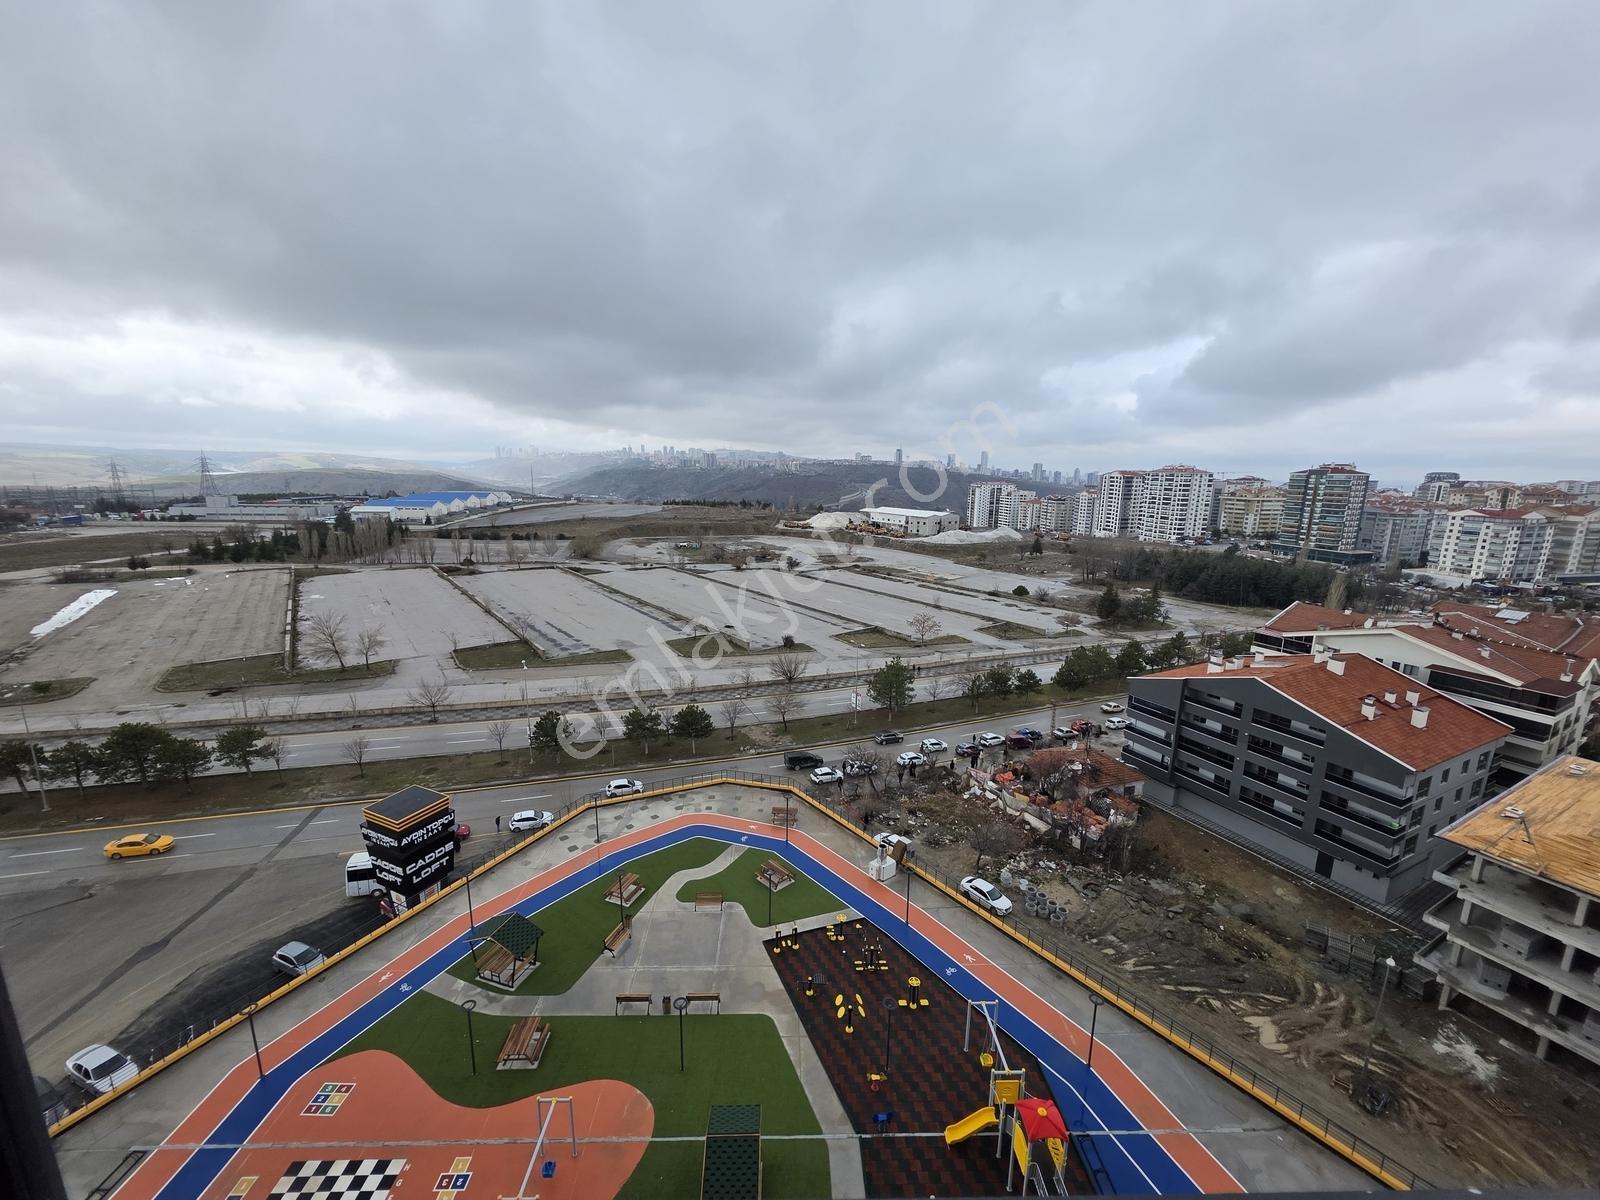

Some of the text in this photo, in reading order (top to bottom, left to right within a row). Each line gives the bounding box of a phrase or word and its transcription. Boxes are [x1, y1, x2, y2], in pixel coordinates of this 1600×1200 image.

[369, 856, 404, 876] CADDE
[406, 841, 454, 875] CADDE
[412, 856, 449, 884] LOFT
[376, 868, 402, 885] LOFT
